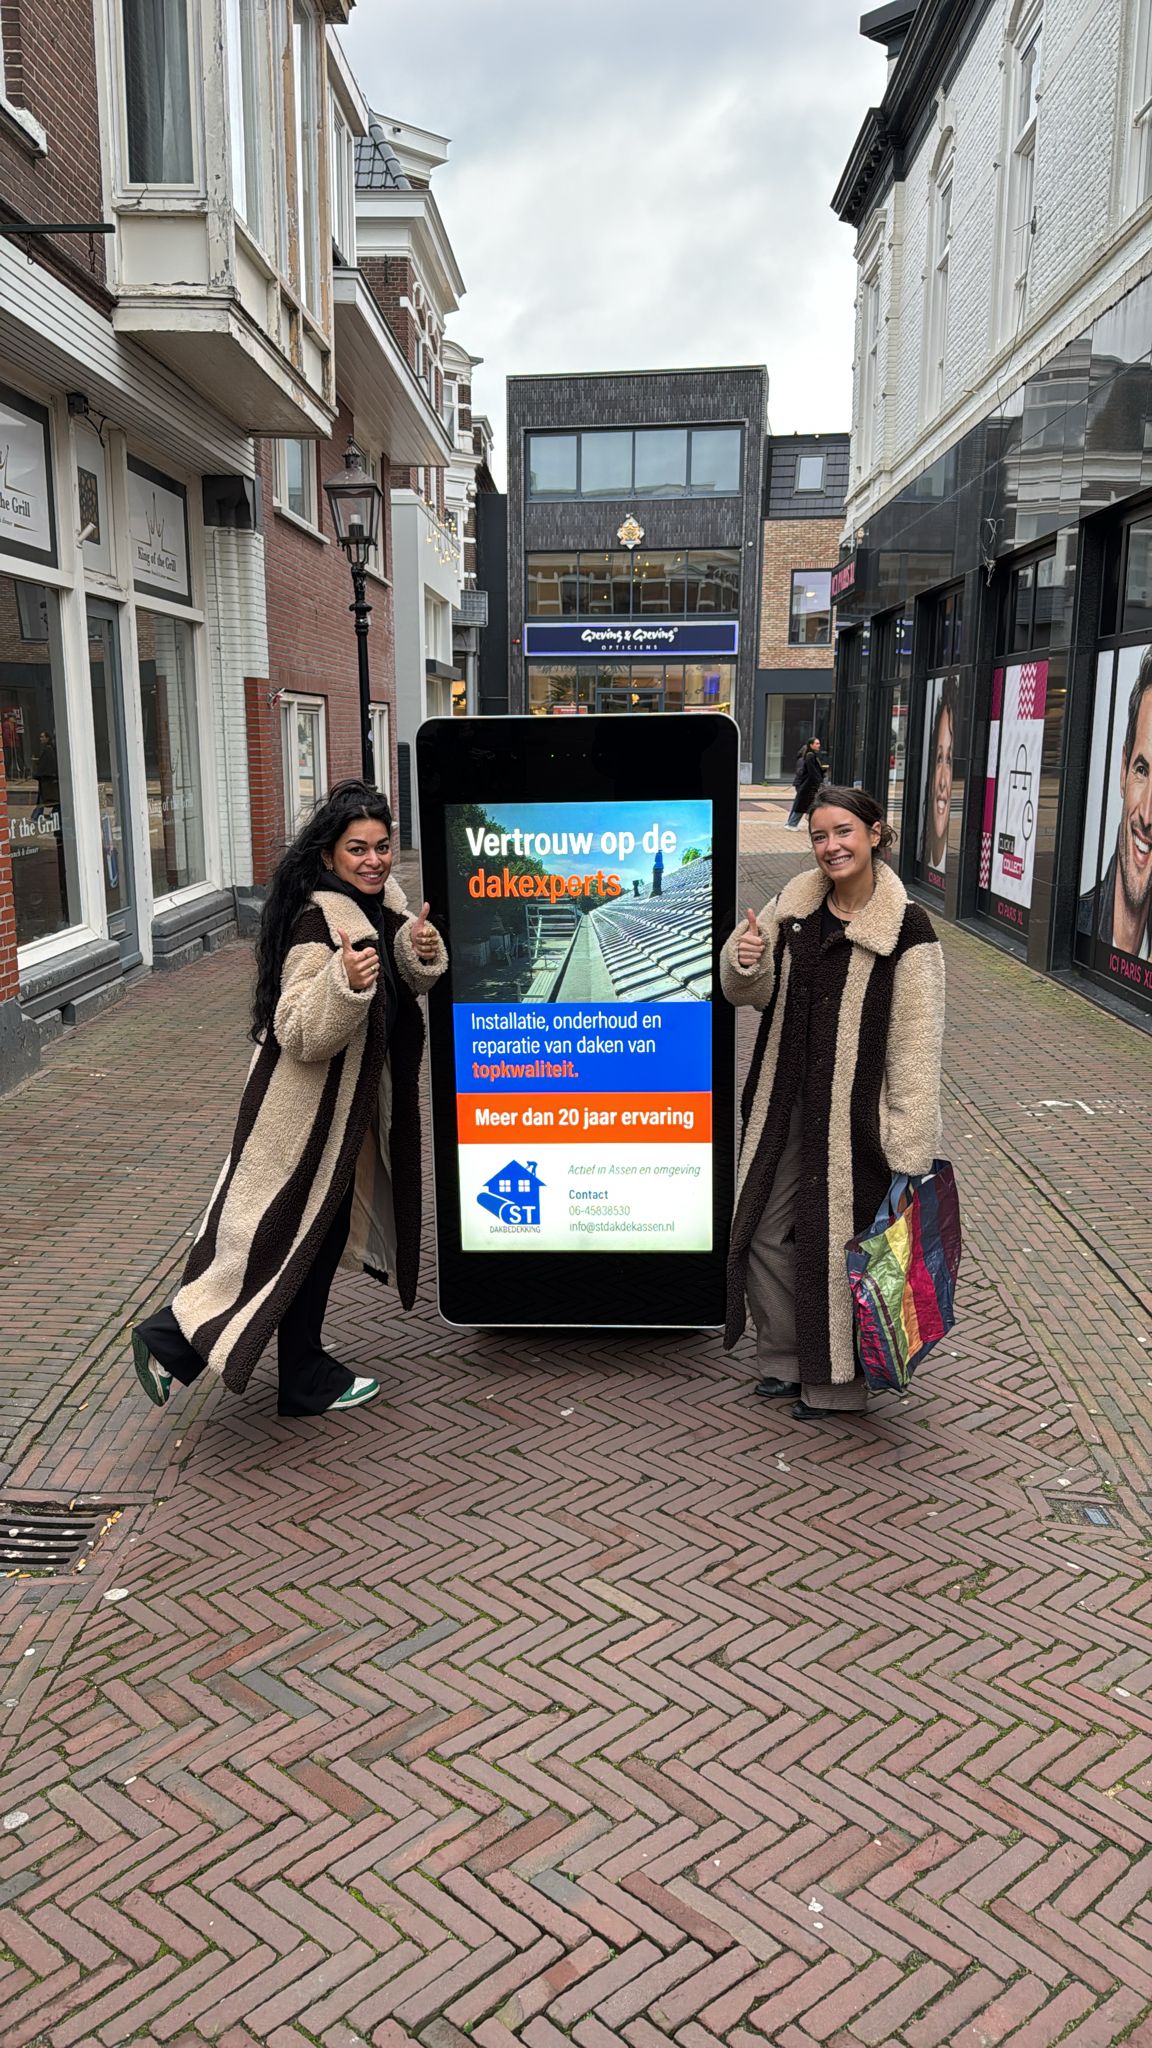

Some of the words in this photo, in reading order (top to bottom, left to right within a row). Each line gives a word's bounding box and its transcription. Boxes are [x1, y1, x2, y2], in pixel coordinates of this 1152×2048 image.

[0, 492, 10, 511] he
[12, 497, 31, 518] Grill
[138, 546, 150, 567] King
[150, 552, 156, 565] of
[165, 557, 176, 572] Grill
[624, 630, 632, 641] &
[162, 796, 170, 812] of
[19, 817, 36, 838] the
[38, 812, 60, 834] Grill
[465, 827, 594, 857] Vertrouw
[600, 830, 635, 861] op
[642, 823, 677, 854] de
[1003, 858, 1022, 874] COLLECT
[468, 868, 622, 903] dakexperts
[1110, 952, 1120, 973] ICI
[1120, 958, 1142, 984] PARIS
[471, 1012, 550, 1032] Installatie,
[553, 1011, 638, 1029] onderhoud
[642, 1015, 662, 1028] en
[472, 1037, 541, 1058] reparatie
[544, 1040, 573, 1054] van
[576, 1036, 624, 1053] daken
[628, 1039, 656, 1053] van
[472, 1060, 579, 1082] topkwaliteit.
[475, 1108, 518, 1126] Meer
[522, 1107, 554, 1126] dan
[558, 1108, 580, 1126] 20
[583, 1107, 617, 1129] jaar
[621, 1107, 694, 1129] ervaring
[568, 1164, 596, 1175] Actief
[597, 1166, 606, 1175] in
[608, 1165, 637, 1175] Assen
[639, 1167, 651, 1175] en
[653, 1164, 701, 1177] omgeving
[568, 1189, 608, 1200] Contact
[509, 1205, 536, 1224] ST
[568, 1205, 631, 1216] 06-45838530
[489, 1225, 541, 1234] DAKBEDEKKING
[569, 1221, 675, 1233] info@stdakdekassen.nl
